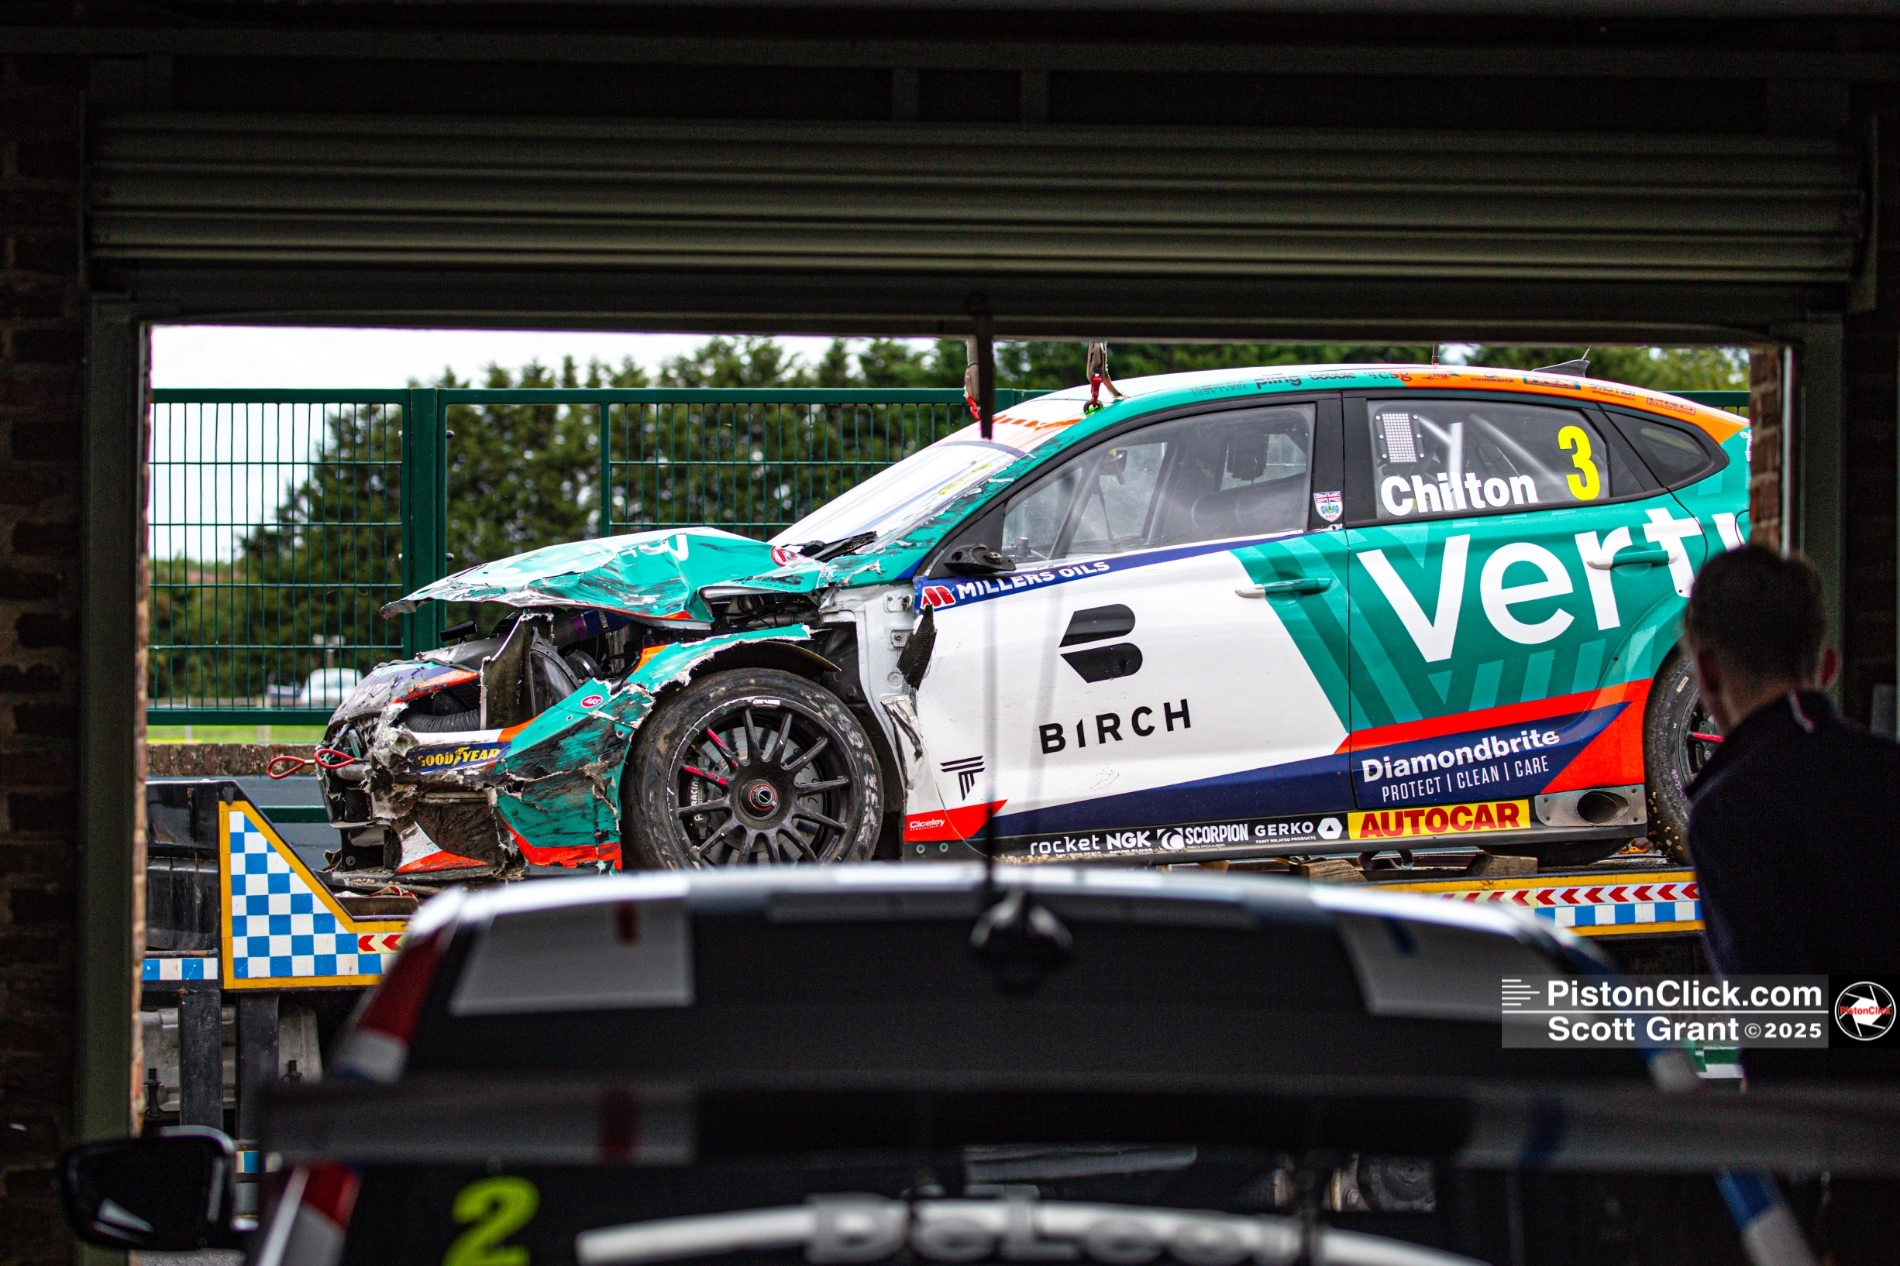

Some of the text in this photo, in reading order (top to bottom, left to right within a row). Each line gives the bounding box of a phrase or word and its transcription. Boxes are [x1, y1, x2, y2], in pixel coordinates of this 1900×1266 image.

[1557, 425, 1600, 501] 3
[1380, 471, 1539, 517] Chilton
[956, 561, 1111, 600] MILLERS OILS
[1356, 507, 1750, 664] vert
[1039, 698, 1191, 754] BIRCH
[1361, 728, 1560, 783] Diamondbrite
[1381, 755, 1550, 803] PROTECT CLEAN CARE
[909, 818, 945, 829] Ciceley
[1106, 830, 1152, 850] NGK
[1185, 823, 1249, 845] SCORPION
[1254, 821, 1314, 837] GERKO
[1359, 802, 1520, 839] AUTOCAR
[1030, 834, 1100, 855] rocket
[442, 1174, 541, 1266] 2
